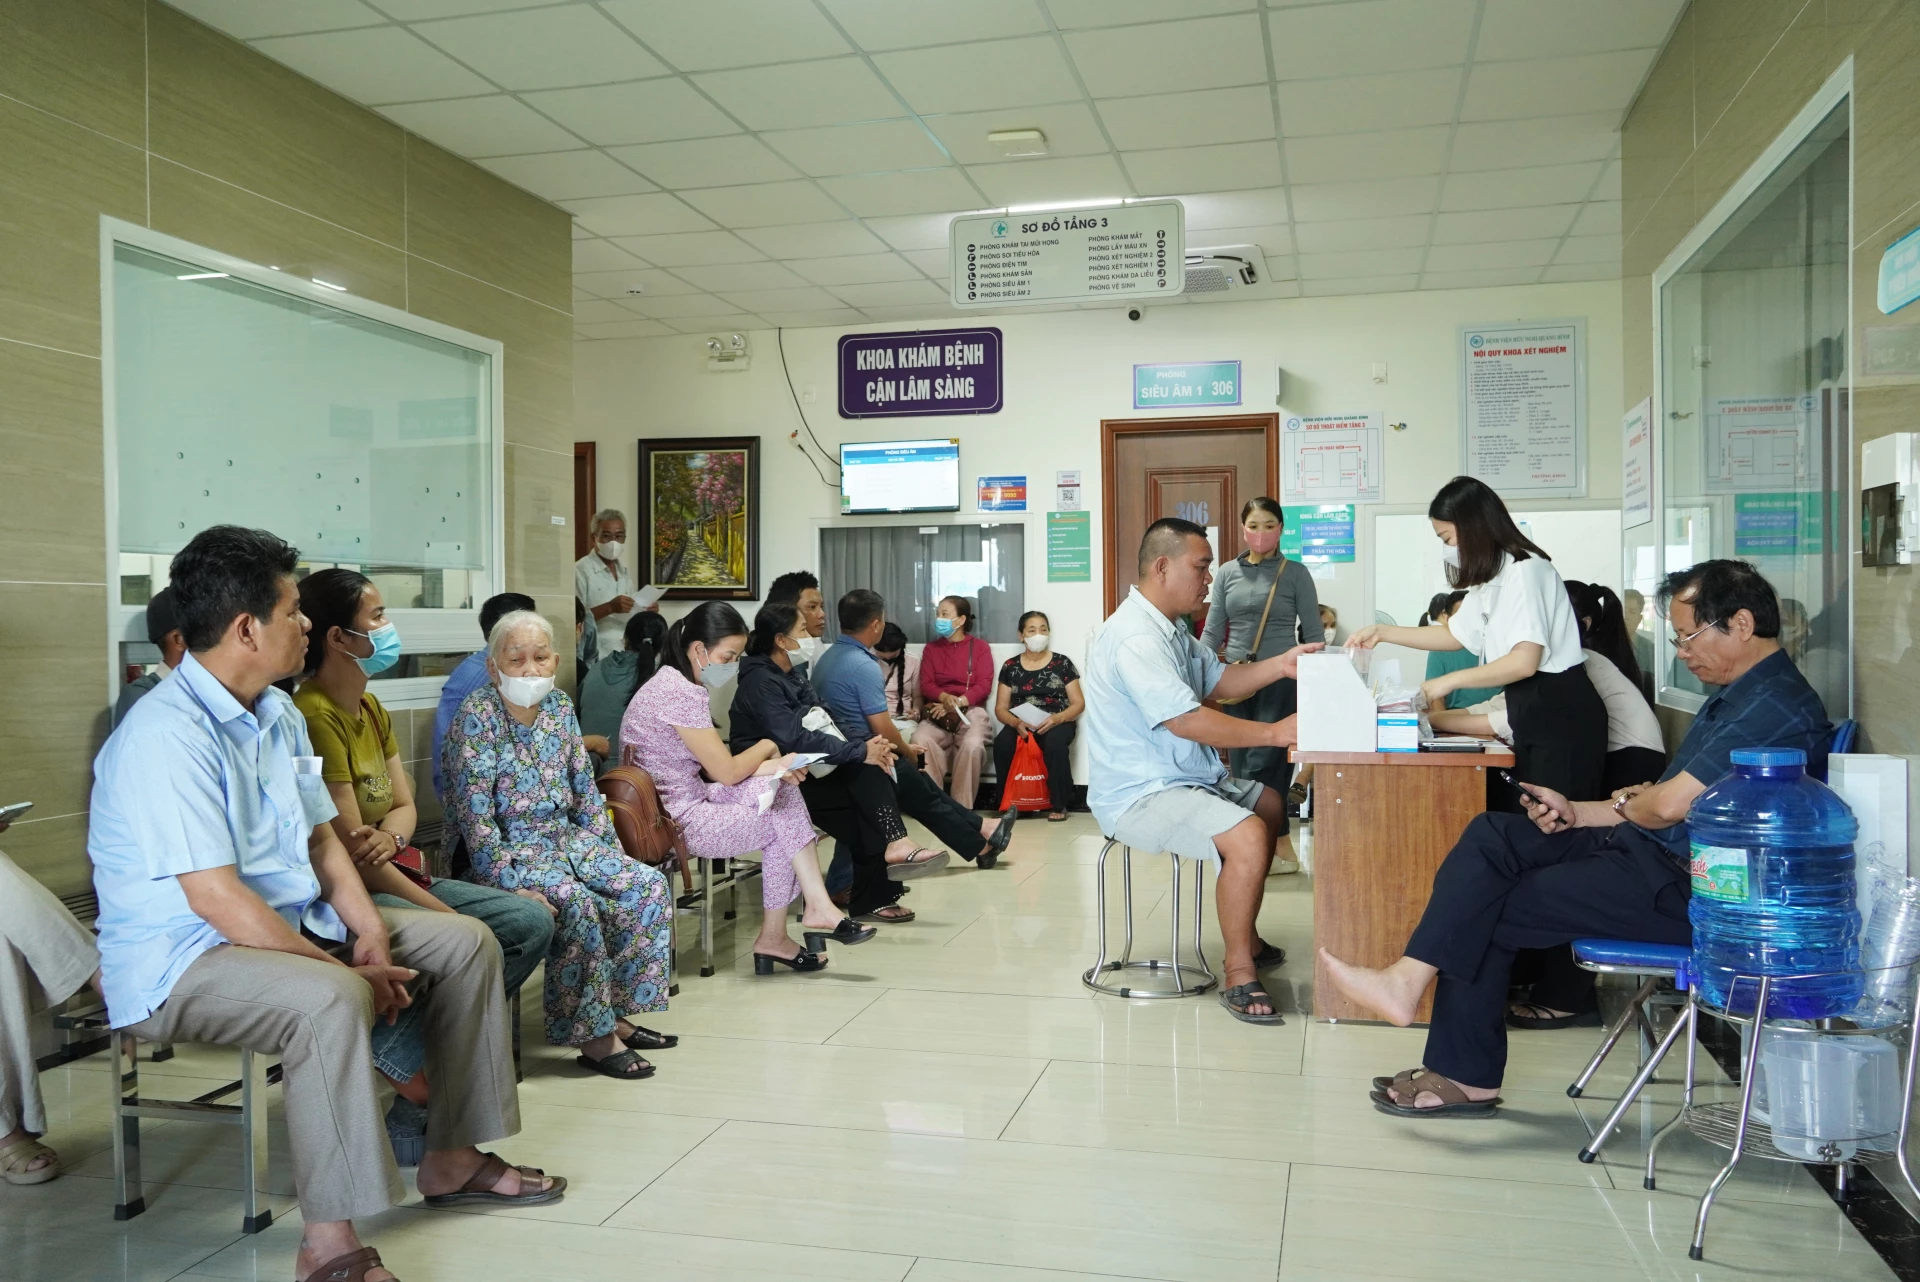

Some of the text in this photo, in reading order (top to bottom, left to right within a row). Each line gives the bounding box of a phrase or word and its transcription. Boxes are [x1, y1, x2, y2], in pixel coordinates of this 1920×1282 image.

[1022, 222, 1038, 234] SƠ
[1101, 218, 1108, 228] 3
[980, 252, 1000, 260] PHÒNG
[1111, 262, 1123, 270] XÉT
[1002, 270, 1019, 278] KHÁM
[1111, 272, 1129, 280] KHÁM
[980, 281, 1001, 289] PHÒNG
[857, 340, 984, 370] KHOA KHÁM BỆNH
[1474, 350, 1486, 358] NỘI
[1524, 347, 1537, 355] XÉT
[1538, 346, 1567, 354] NGHIỆM
[1156, 370, 1186, 379] PHÒNG
[866, 373, 974, 407] CẬN LÂM SÀNG
[1141, 381, 1233, 398] SIÊU ÂM 1 306
[1175, 501, 1209, 525] 306
